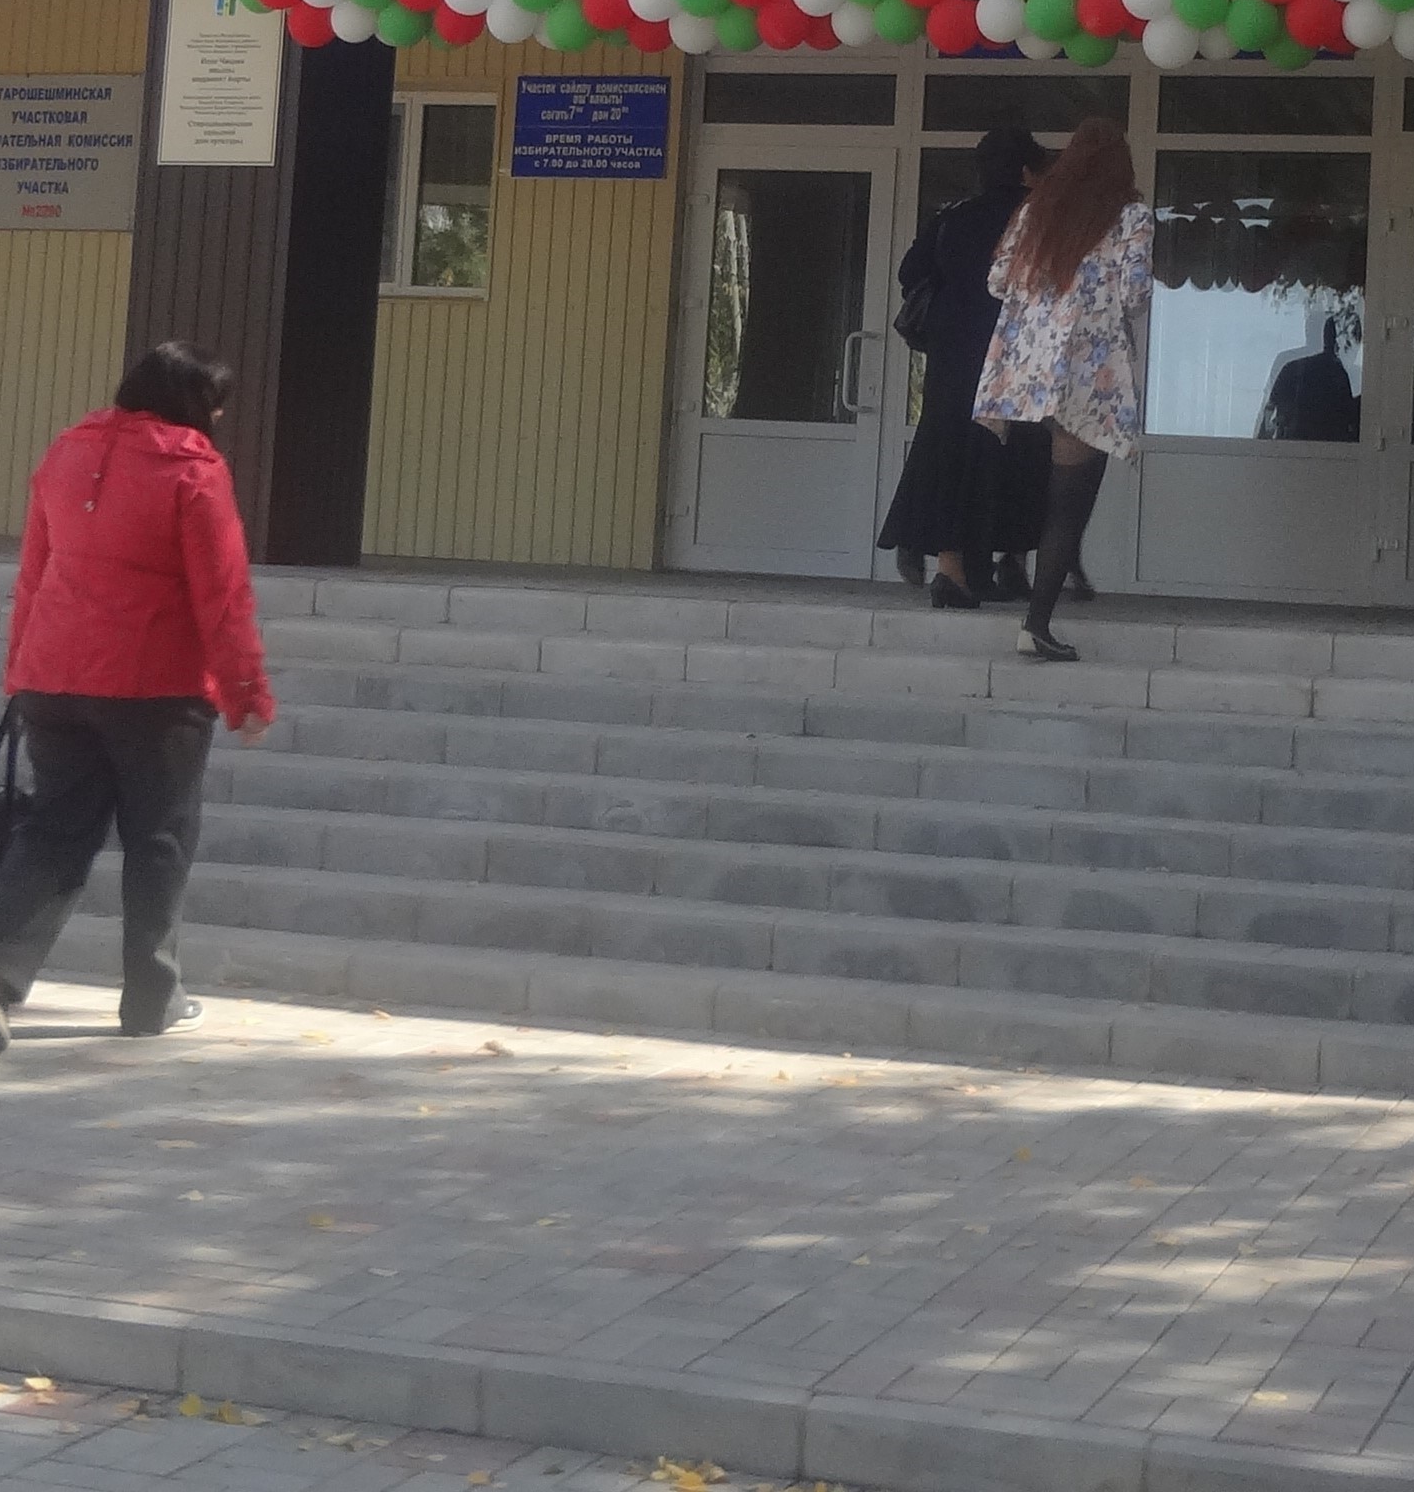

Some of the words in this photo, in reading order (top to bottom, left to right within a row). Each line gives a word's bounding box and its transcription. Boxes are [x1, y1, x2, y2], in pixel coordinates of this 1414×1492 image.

[12, 111, 87, 124] УЧАСТКОВАЯ
[68, 134, 133, 147] КОМИССИЯ
[545, 134, 581, 144] ВРЕМЯ
[587, 134, 633, 144] РАБОТЫ
[514, 147, 612, 157] ИЗБИРАТЕЛЬНОГО
[614, 147, 663, 157] УЧАСТКА
[565, 161, 579, 169] до
[610, 160, 641, 169] часов
[17, 181, 69, 194] УЧАСТКА
